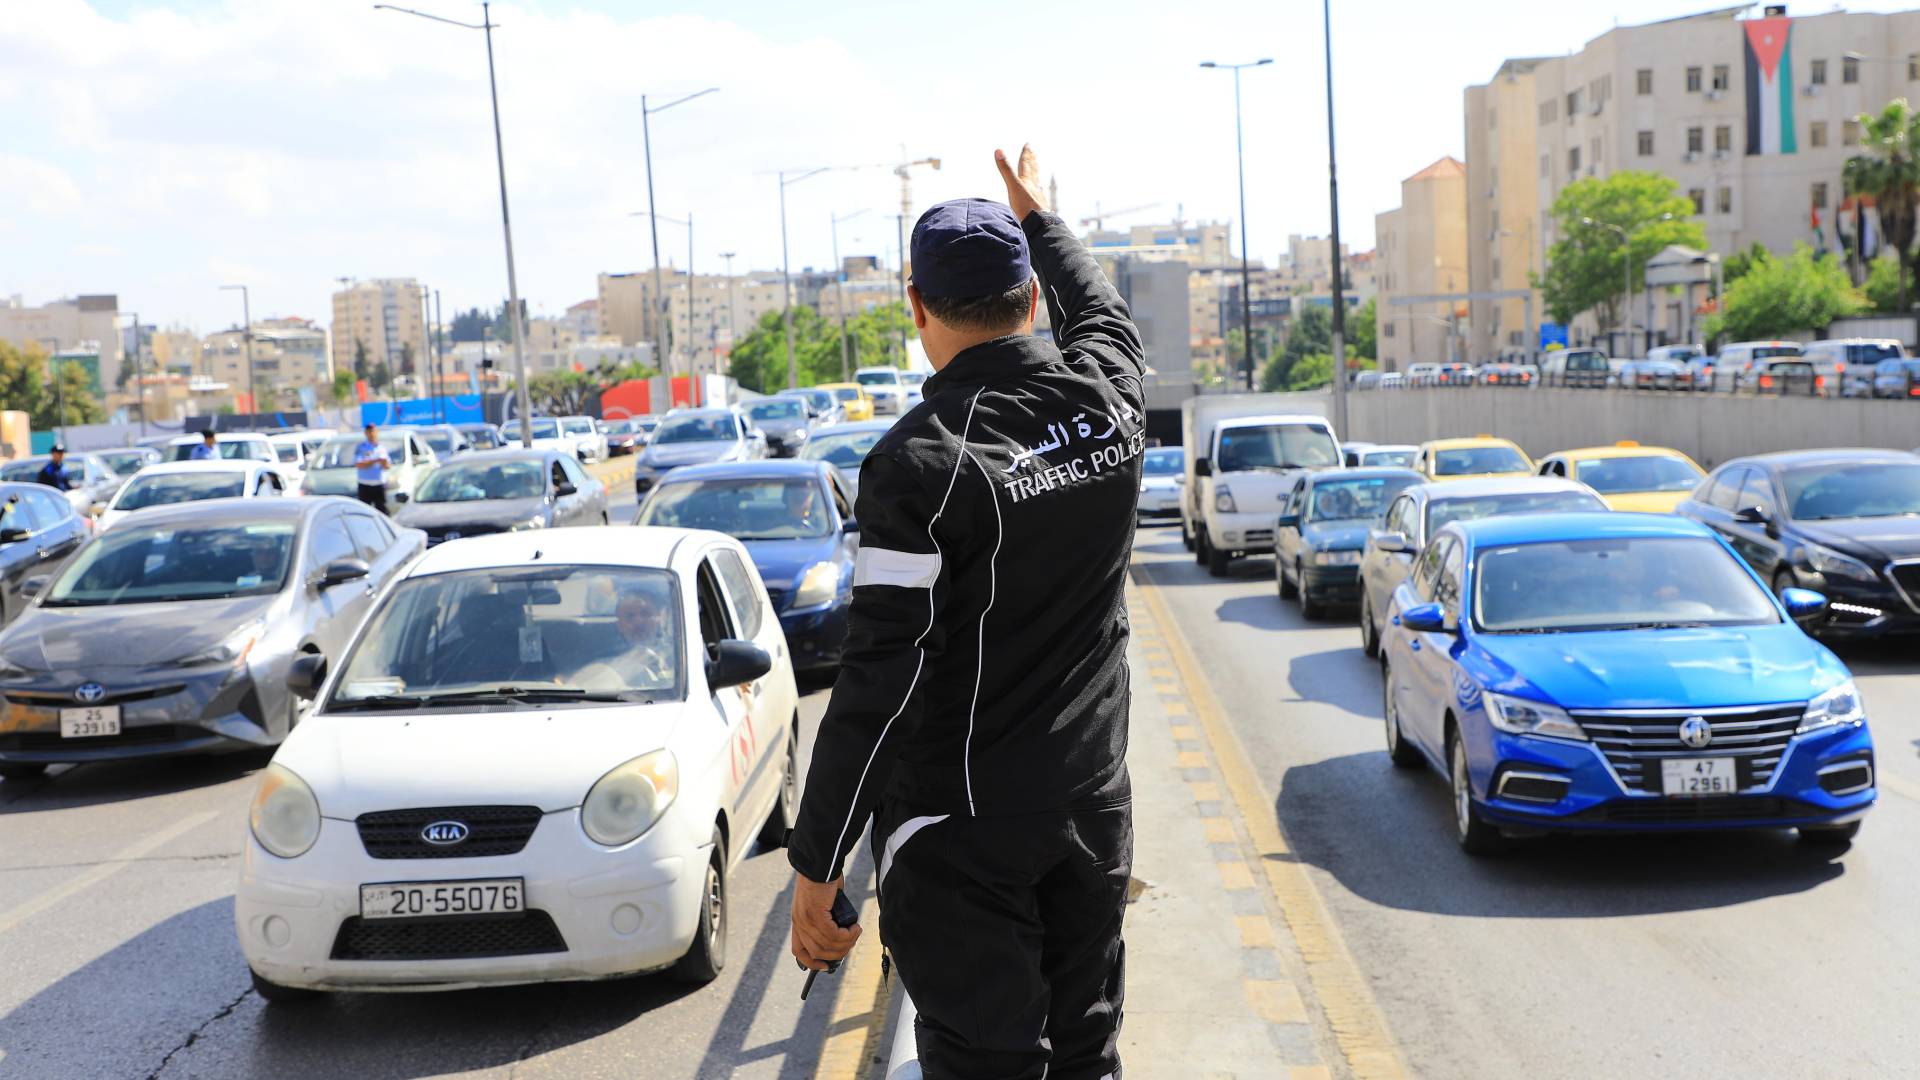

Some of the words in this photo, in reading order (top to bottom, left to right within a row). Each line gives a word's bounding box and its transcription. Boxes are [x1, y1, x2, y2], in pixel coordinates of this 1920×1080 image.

[1000, 421, 1070, 473] السير
[1004, 458, 1088, 503] TRAFFIC
[1090, 428, 1146, 473] POLICE
[86, 709, 102, 721] 25
[1695, 761, 1714, 775] 47
[1681, 776, 1730, 792] 12961
[429, 826, 461, 840] KIA
[391, 886, 518, 915] 20-55076
